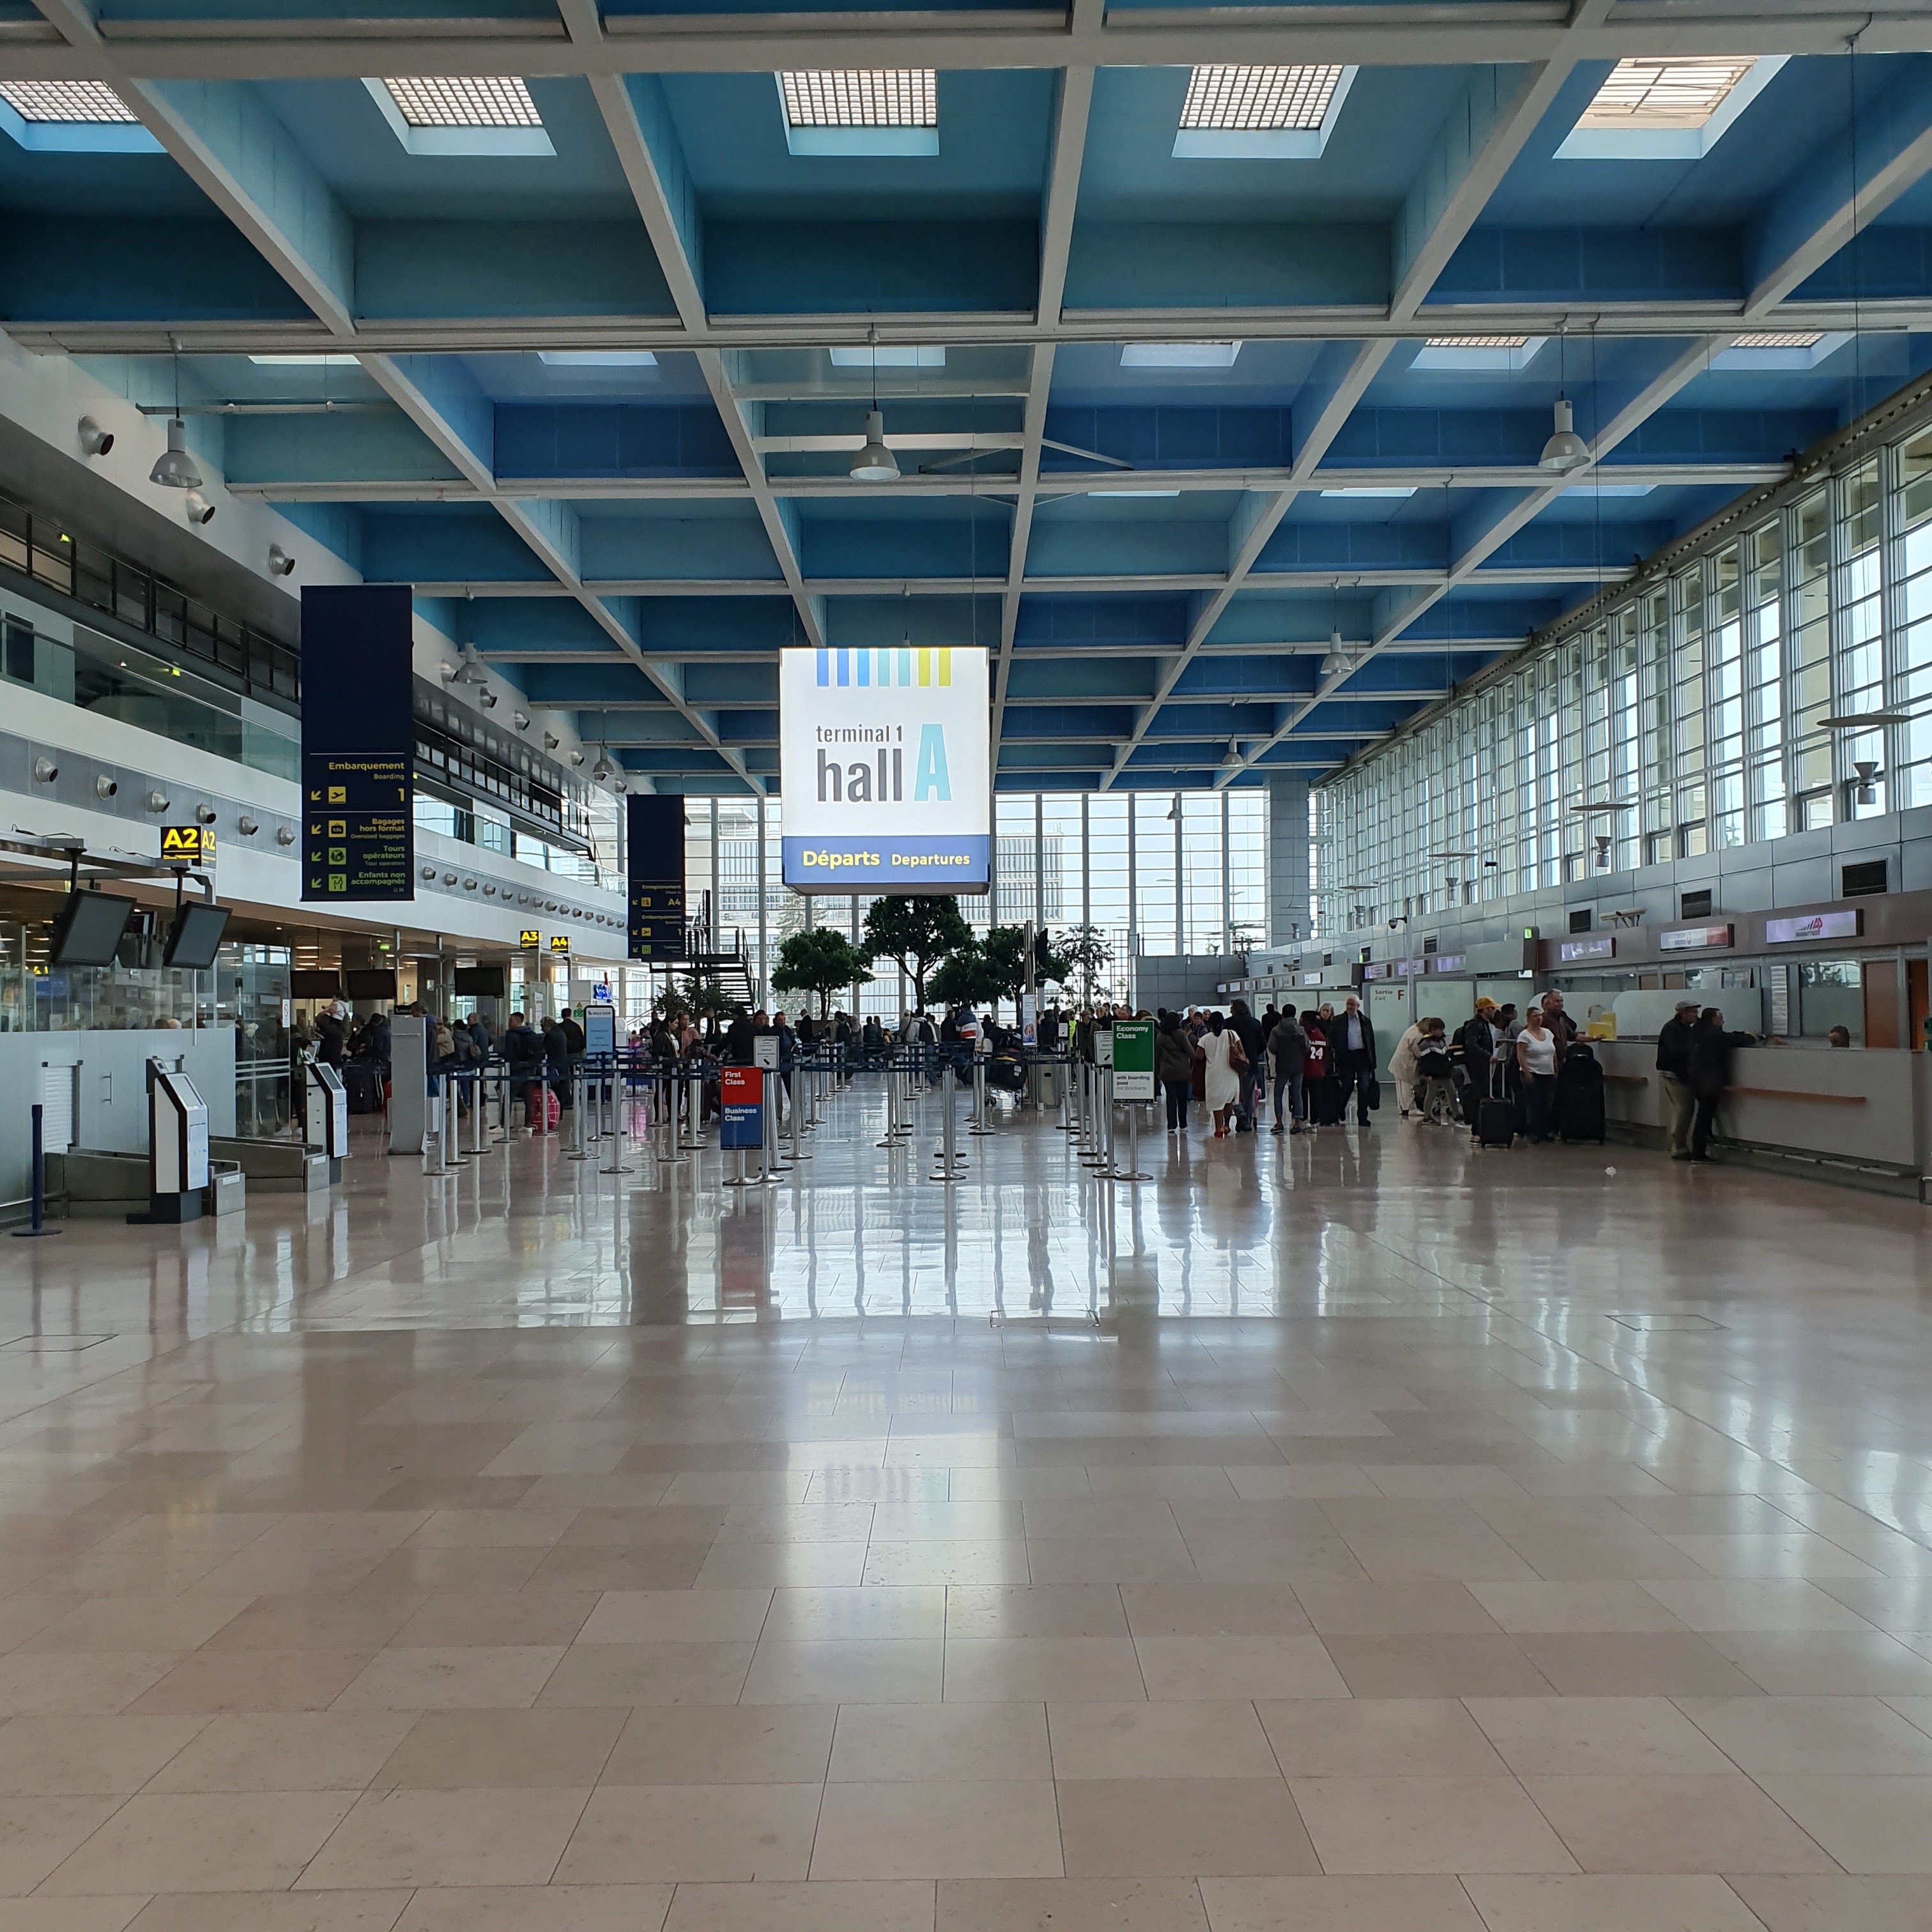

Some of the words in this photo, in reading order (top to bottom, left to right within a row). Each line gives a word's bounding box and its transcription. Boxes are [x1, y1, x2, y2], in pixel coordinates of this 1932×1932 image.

[816, 724, 889, 742] terminal
[896, 725, 902, 742] 1
[328, 762, 404, 770] Embarquement
[817, 748, 902, 802] hall
[914, 724, 952, 802] A
[397, 788, 404, 802] 1
[163, 828, 199, 848] A2
[202, 829, 216, 850] A2
[363, 852, 405, 860] opérateurs
[802, 849, 880, 870] Départs
[891, 854, 970, 868] Departures
[521, 931, 538, 941] A3
[551, 937, 567, 946] A4
[1398, 989, 1404, 1000] F
[1310, 1046, 1324, 1060] 24
